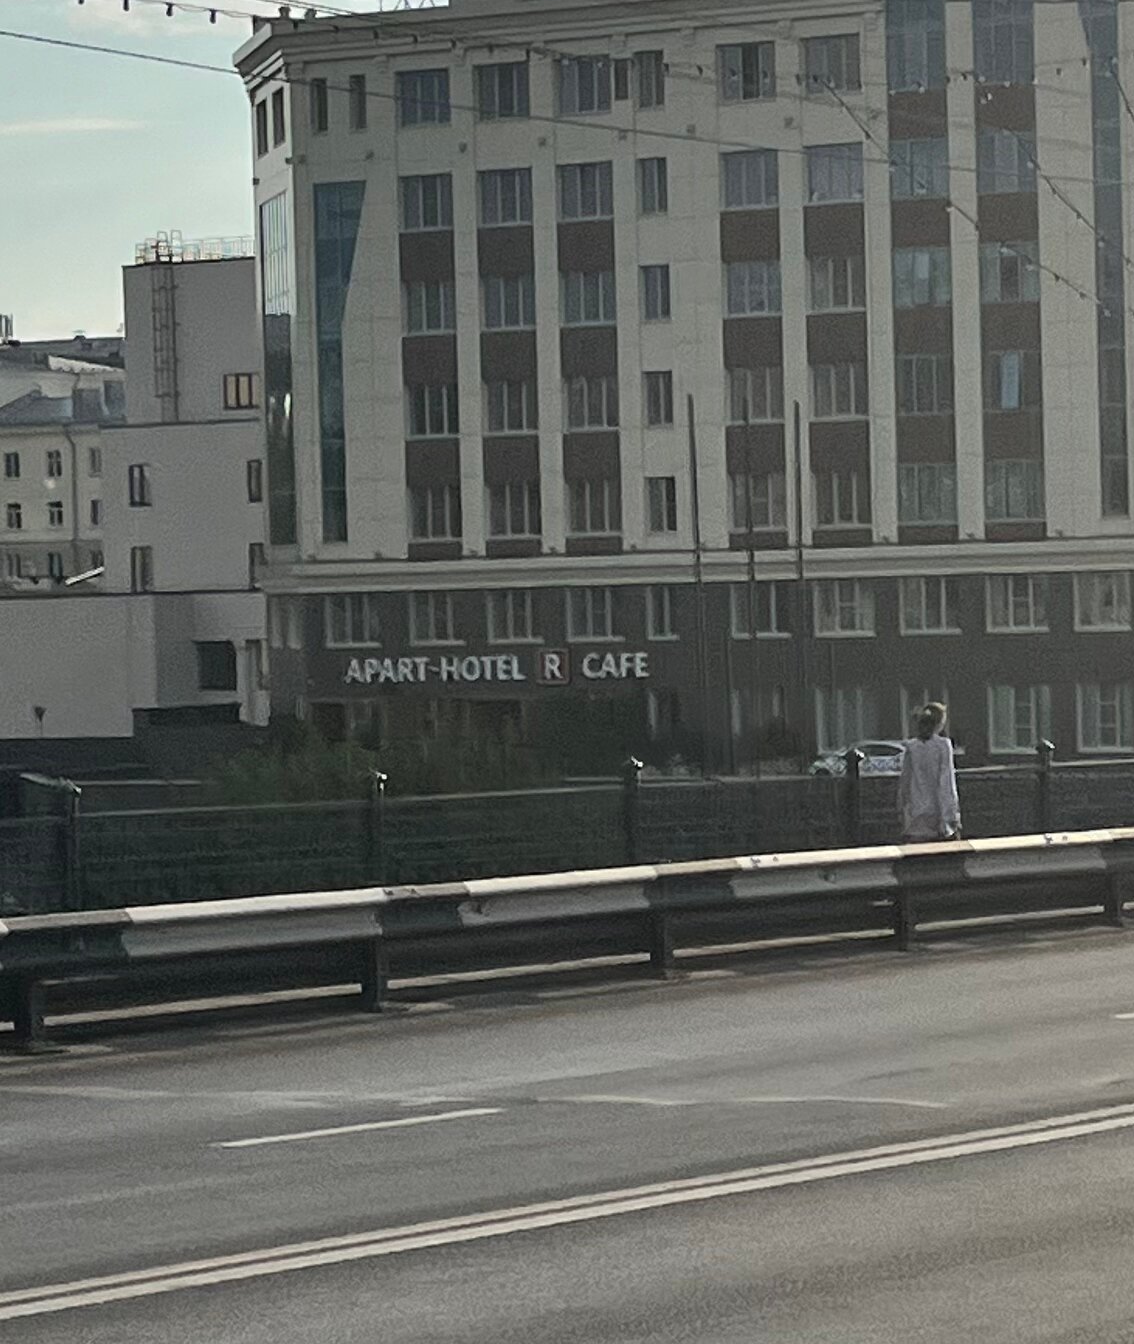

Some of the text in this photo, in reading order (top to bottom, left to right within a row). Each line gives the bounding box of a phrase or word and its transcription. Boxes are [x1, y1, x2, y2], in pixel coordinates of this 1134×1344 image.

[345, 652, 650, 684] APART-HOTEL R CAFE
